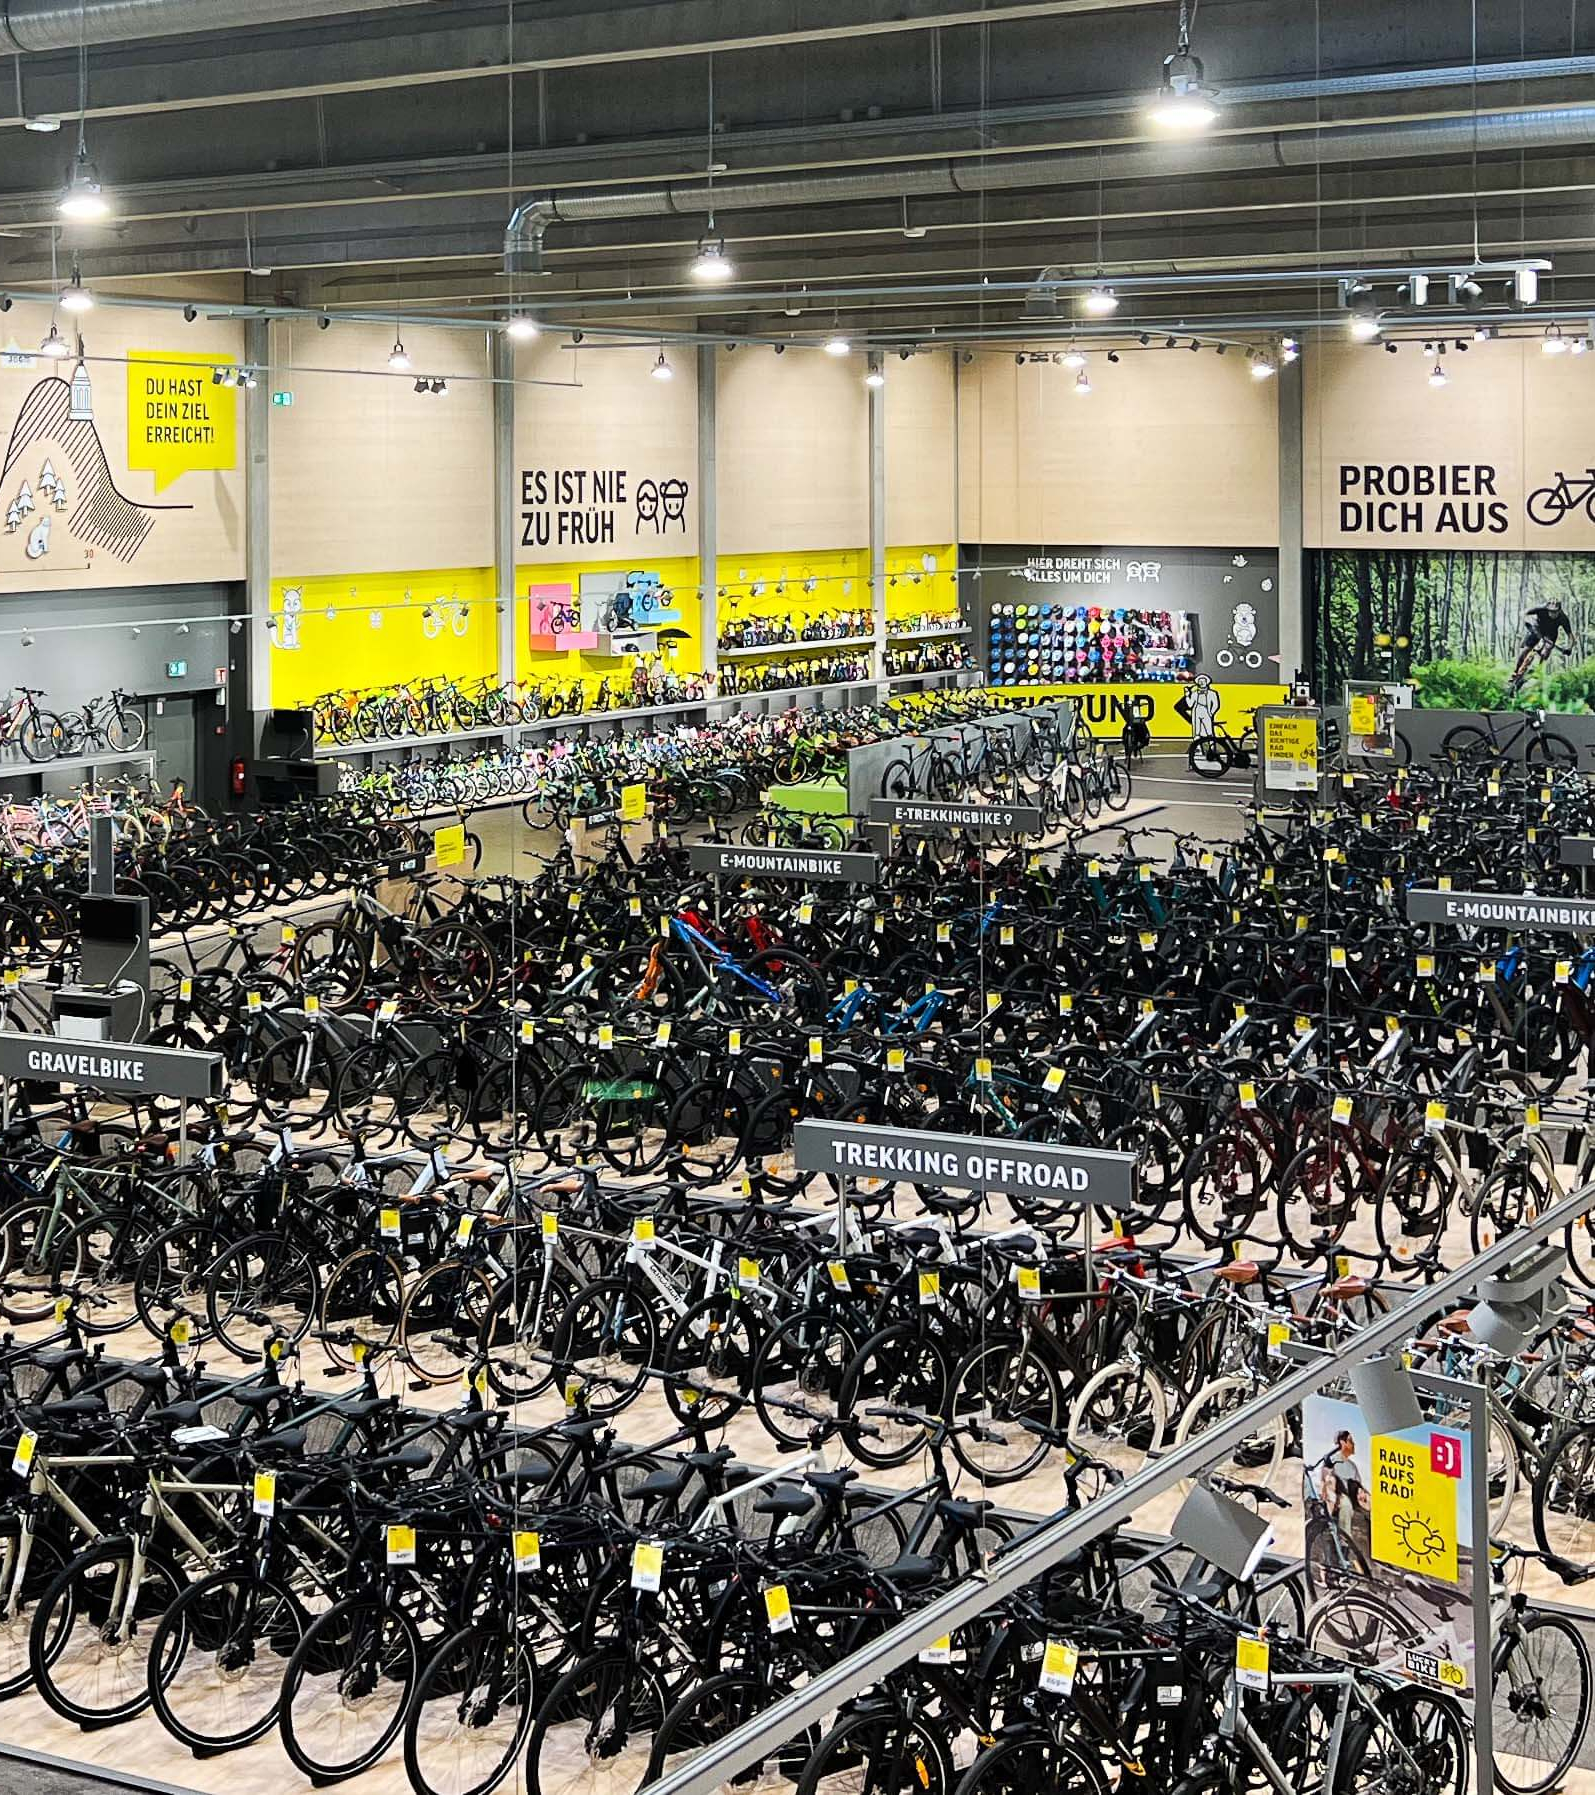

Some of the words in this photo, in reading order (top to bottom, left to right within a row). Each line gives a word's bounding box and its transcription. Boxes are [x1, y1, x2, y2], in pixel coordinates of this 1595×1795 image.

[147, 378, 164, 396] DU
[169, 379, 203, 396] HAST
[147, 402, 178, 419] DEIN
[181, 403, 210, 420] ZIEL
[147, 426, 214, 443] ERREICHT!
[522, 470, 547, 504] ES
[554, 470, 586, 504] IST
[593, 470, 627, 503] NIE
[1340, 464, 1497, 497] PROBIER
[522, 511, 550, 546] ZU
[558, 507, 614, 544] FRÜH
[1340, 502, 1423, 534] DICH
[1437, 502, 1509, 534] AUS
[1027, 557, 1054, 570] HIER
[1055, 557, 1092, 570] DREHT
[1094, 558, 1121, 570] SICH
[1062, 571, 1081, 583] UM
[1084, 571, 1110, 583] DICH
[895, 807, 1001, 826] E-TREKKINGBIKE
[720, 852, 842, 875] E-MOUNTAINBIKE
[29, 1050, 144, 1082] GRAVELBIKE
[832, 1140, 958, 1178] TREKKING
[968, 1155, 1089, 1192] OFFROAD
[1380, 1448, 1414, 1469] RAUS
[1380, 1466, 1414, 1485] AUFS
[1380, 1480, 1413, 1499] RAD!
[1407, 1660, 1437, 1677] BIKE
